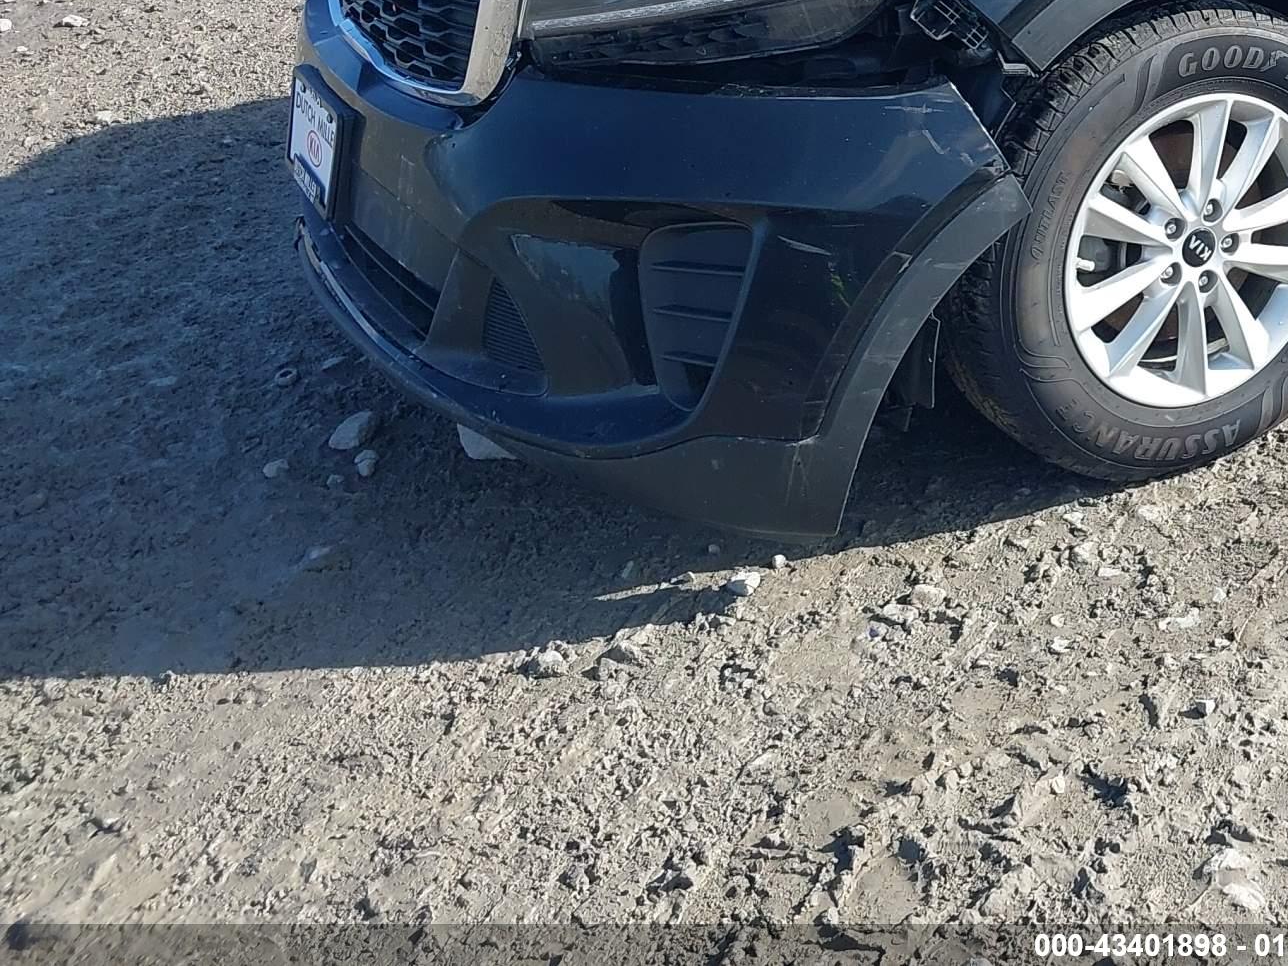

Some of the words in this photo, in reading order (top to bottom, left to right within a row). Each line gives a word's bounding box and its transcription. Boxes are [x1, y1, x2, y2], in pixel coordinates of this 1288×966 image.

[295, 90, 317, 127] DUTCH
[308, 136, 321, 164] KIA
[1189, 234, 1213, 261] KIA
[1055, 398, 1241, 461] ASSURANCE
